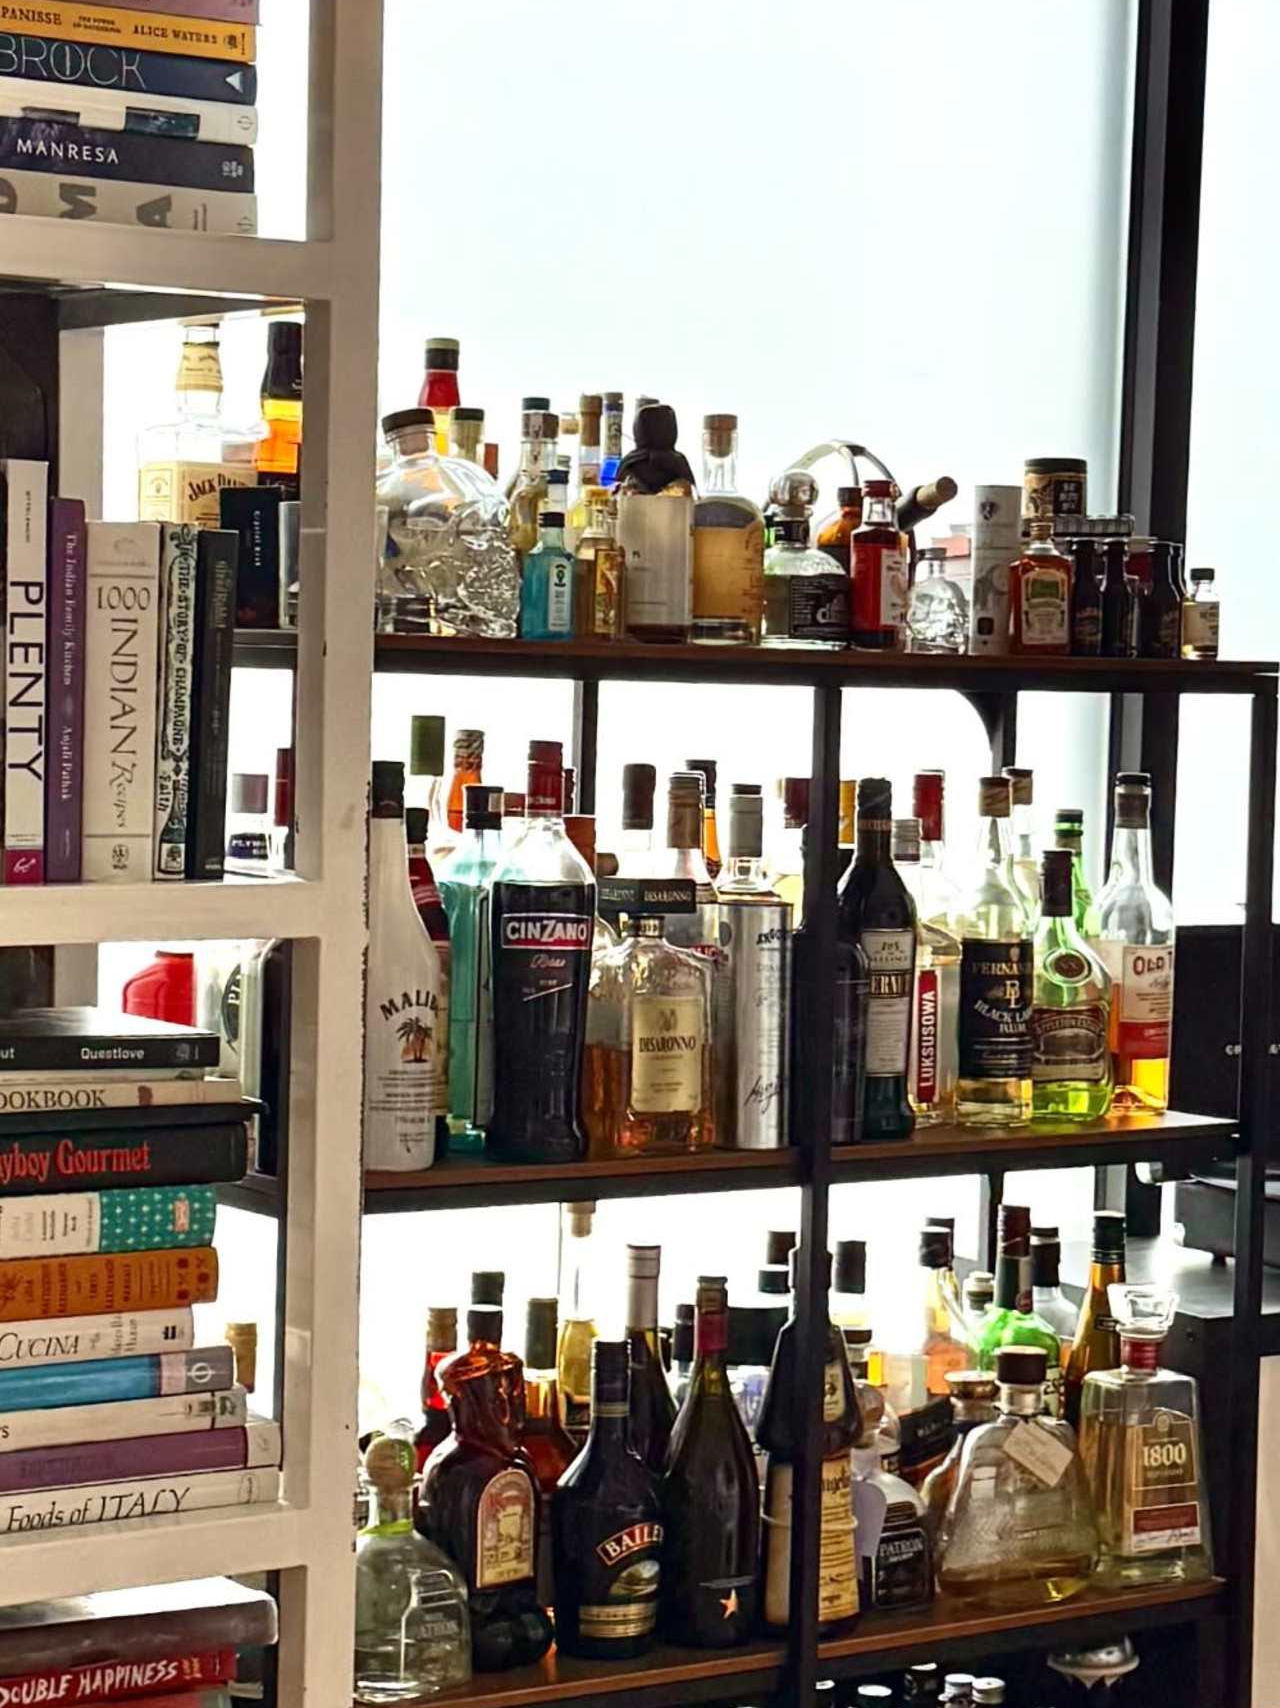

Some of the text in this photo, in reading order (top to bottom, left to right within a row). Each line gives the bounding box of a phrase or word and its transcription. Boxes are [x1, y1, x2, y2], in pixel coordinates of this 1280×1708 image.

[1, 6, 62, 25] PANISSE
[16, 138, 120, 165] MANRESA
[8, 581, 44, 781] PLENTY
[505, 920, 588, 942] CINZANO
[1133, 956, 1166, 975] OLD
[974, 999, 1014, 1023] BLACK
[920, 990, 935, 1087] LUKSUSOWA
[999, 1023, 1027, 1033] RUM
[638, 1037, 697, 1052] DISARONNO
[56, 1139, 153, 1174] Gourmet
[1142, 1442, 1187, 1467] 1800
